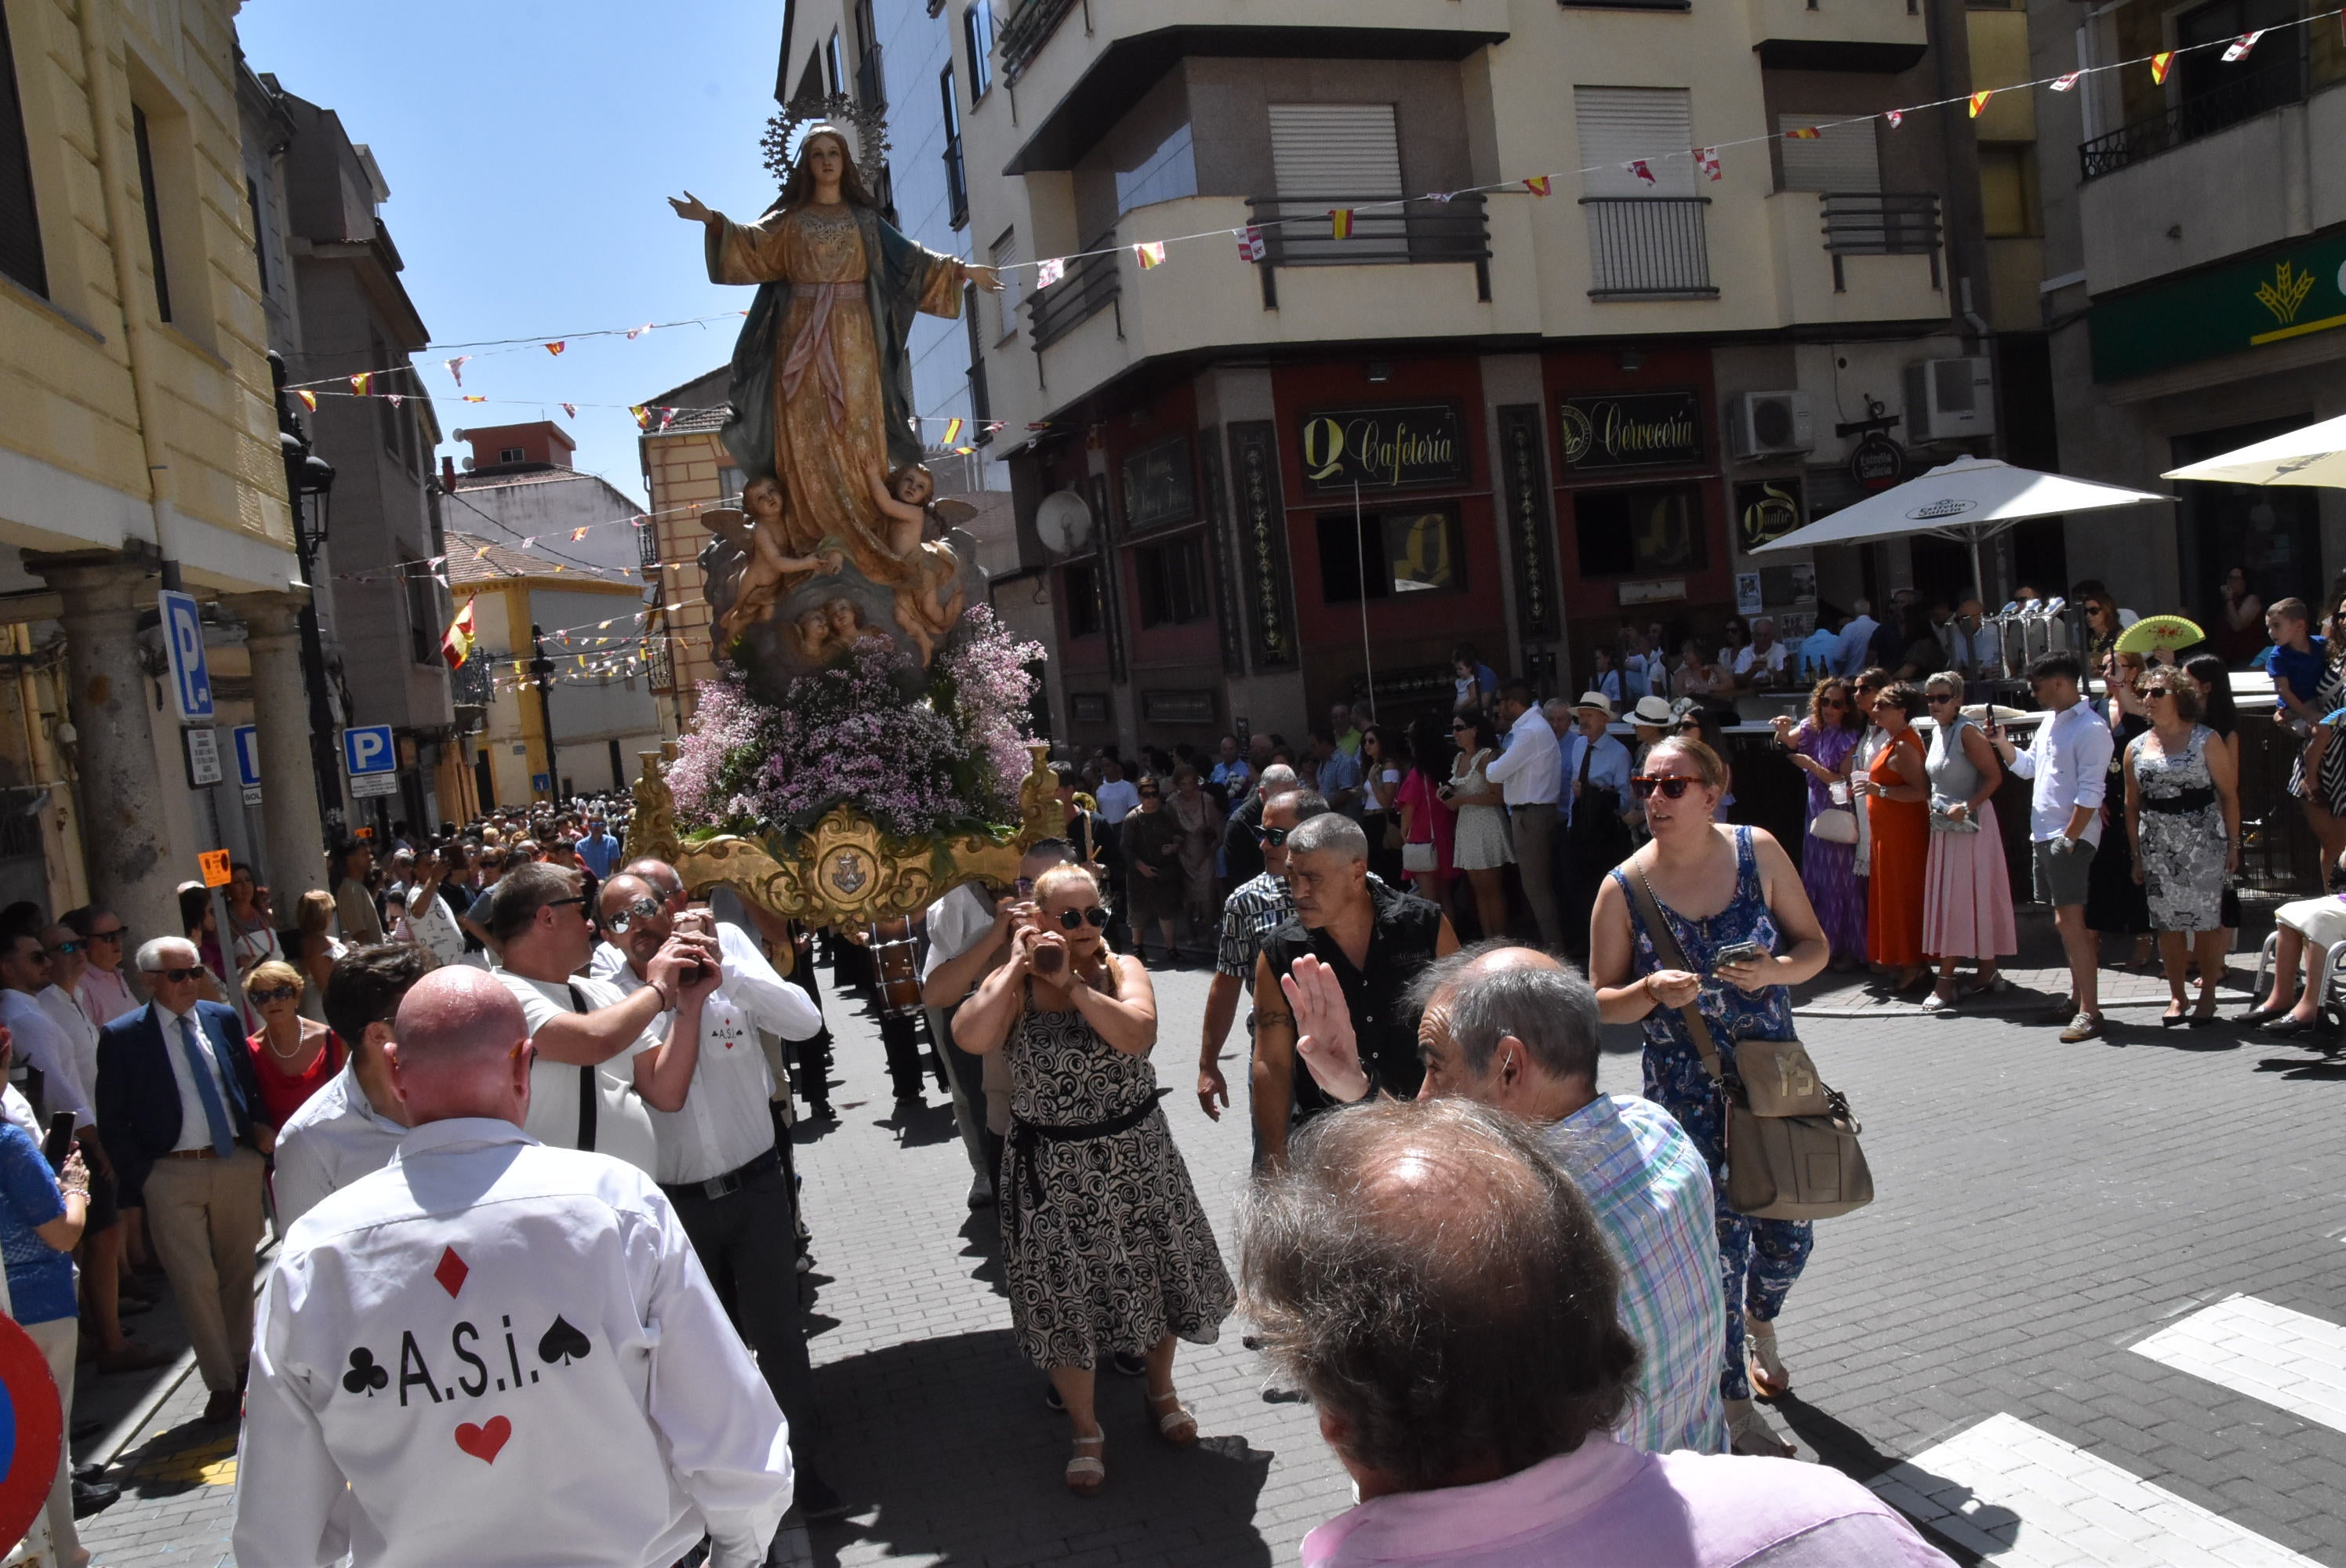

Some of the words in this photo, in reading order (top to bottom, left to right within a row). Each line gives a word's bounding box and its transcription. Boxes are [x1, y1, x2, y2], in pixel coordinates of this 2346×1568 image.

[1303, 417, 1345, 481] Q
[1345, 418, 1454, 486] Cafetería
[172, 607, 200, 711] P
[352, 731, 383, 770] P
